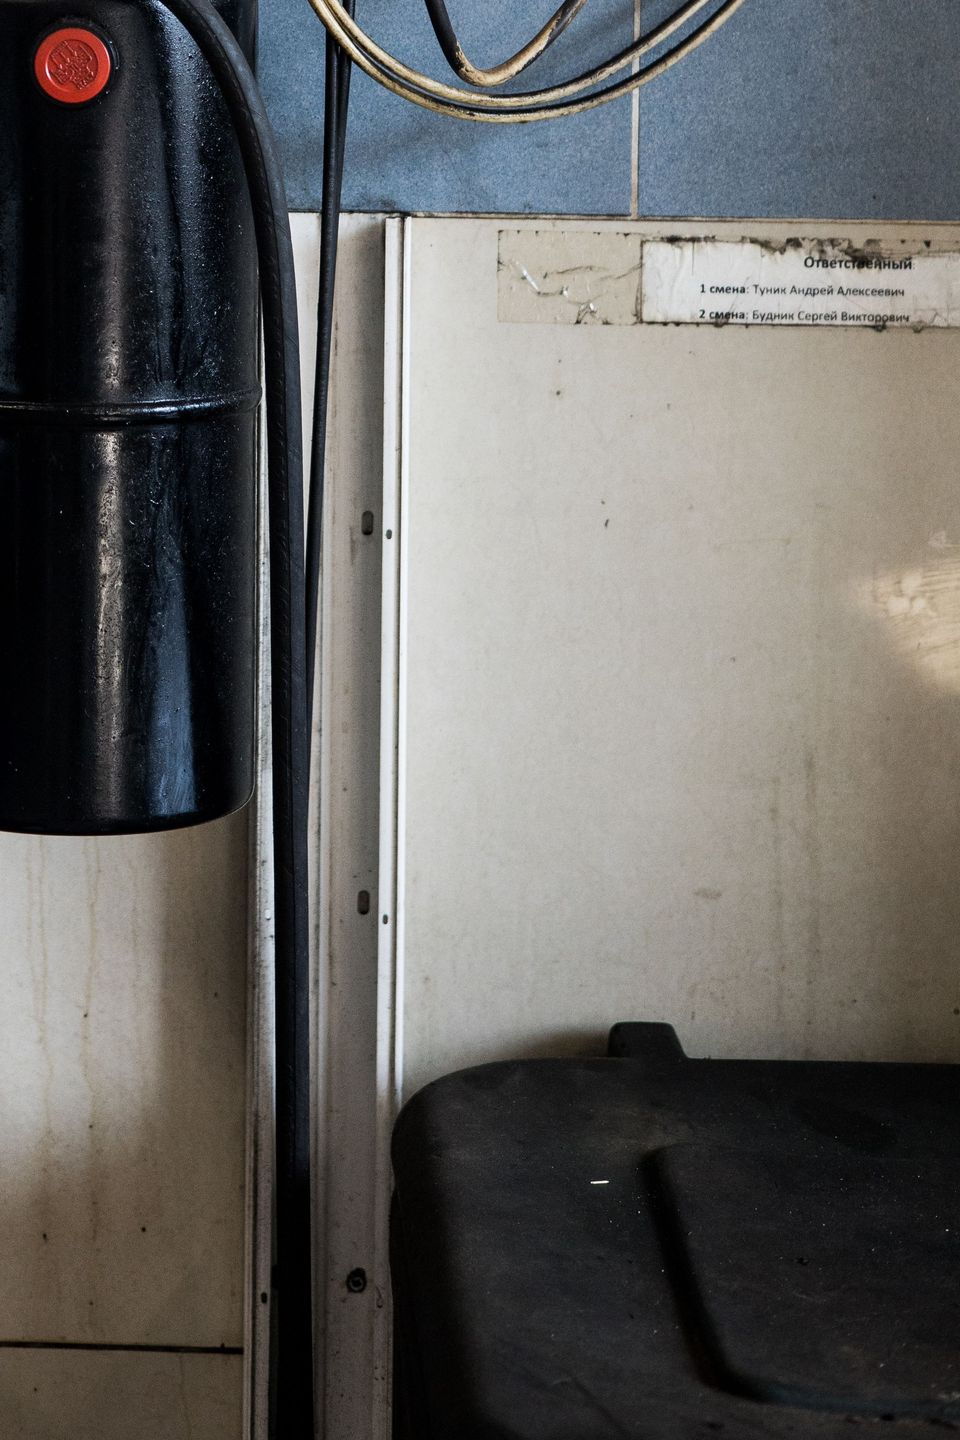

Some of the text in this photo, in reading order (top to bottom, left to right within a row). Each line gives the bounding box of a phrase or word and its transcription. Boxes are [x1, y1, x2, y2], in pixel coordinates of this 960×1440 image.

[700, 284, 905, 298] 1 смена: Туник Андрей Алексеевич
[699, 309, 910, 323] 2 смена: Будник Сергей Викторович
